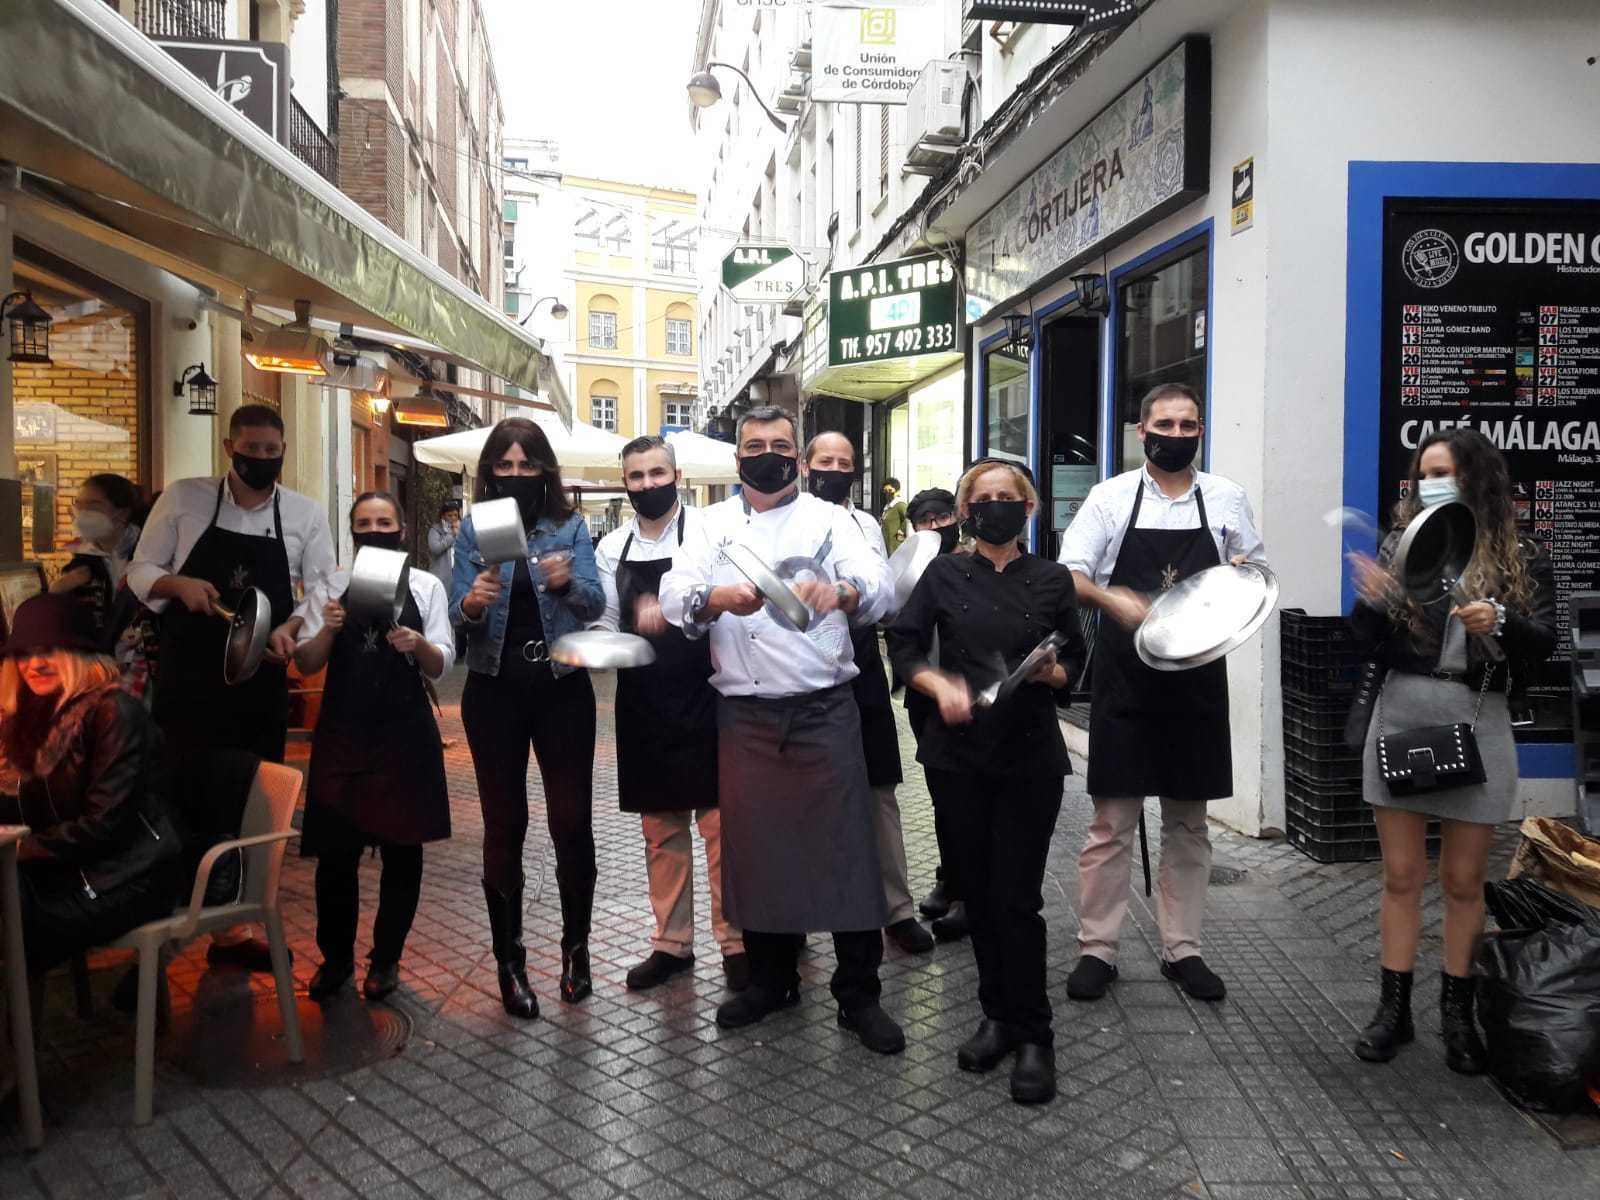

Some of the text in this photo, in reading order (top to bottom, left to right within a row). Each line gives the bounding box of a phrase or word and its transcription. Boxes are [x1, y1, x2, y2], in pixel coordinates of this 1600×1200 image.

[860, 52, 896, 64] Unión
[823, 64, 922, 78] de Consumidor
[842, 78, 914, 90] de Córdoba
[1015, 147, 1124, 253] CORTIJERA
[1464, 231, 1584, 264] GOLDEN
[840, 258, 954, 301] A.P.I. TRES
[754, 279, 794, 293] TRES
[1422, 305, 1497, 313] KIKO VENENO TRIBUTO
[1404, 313, 1420, 323] 06
[1541, 314, 1557, 324] 07
[1422, 325, 1445, 333] LAURA
[1471, 325, 1491, 333] BAND
[840, 322, 952, 360] Tlf. 957 492 333
[1404, 334, 1420, 344] 13
[1540, 335, 1557, 344] 14
[1446, 346, 1460, 354] CON
[1403, 354, 1420, 364] 20
[1539, 355, 1557, 365] 21
[1403, 375, 1420, 384] 27
[1540, 376, 1556, 386] 27
[1403, 395, 1419, 405] 28
[1479, 414, 1600, 450] MÁLAGA
[1558, 453, 1594, 465] Málaga,
[1554, 480, 1594, 488] JAZZ NIGHT
[1536, 488, 1553, 499] 05
[1536, 509, 1553, 519] 06
